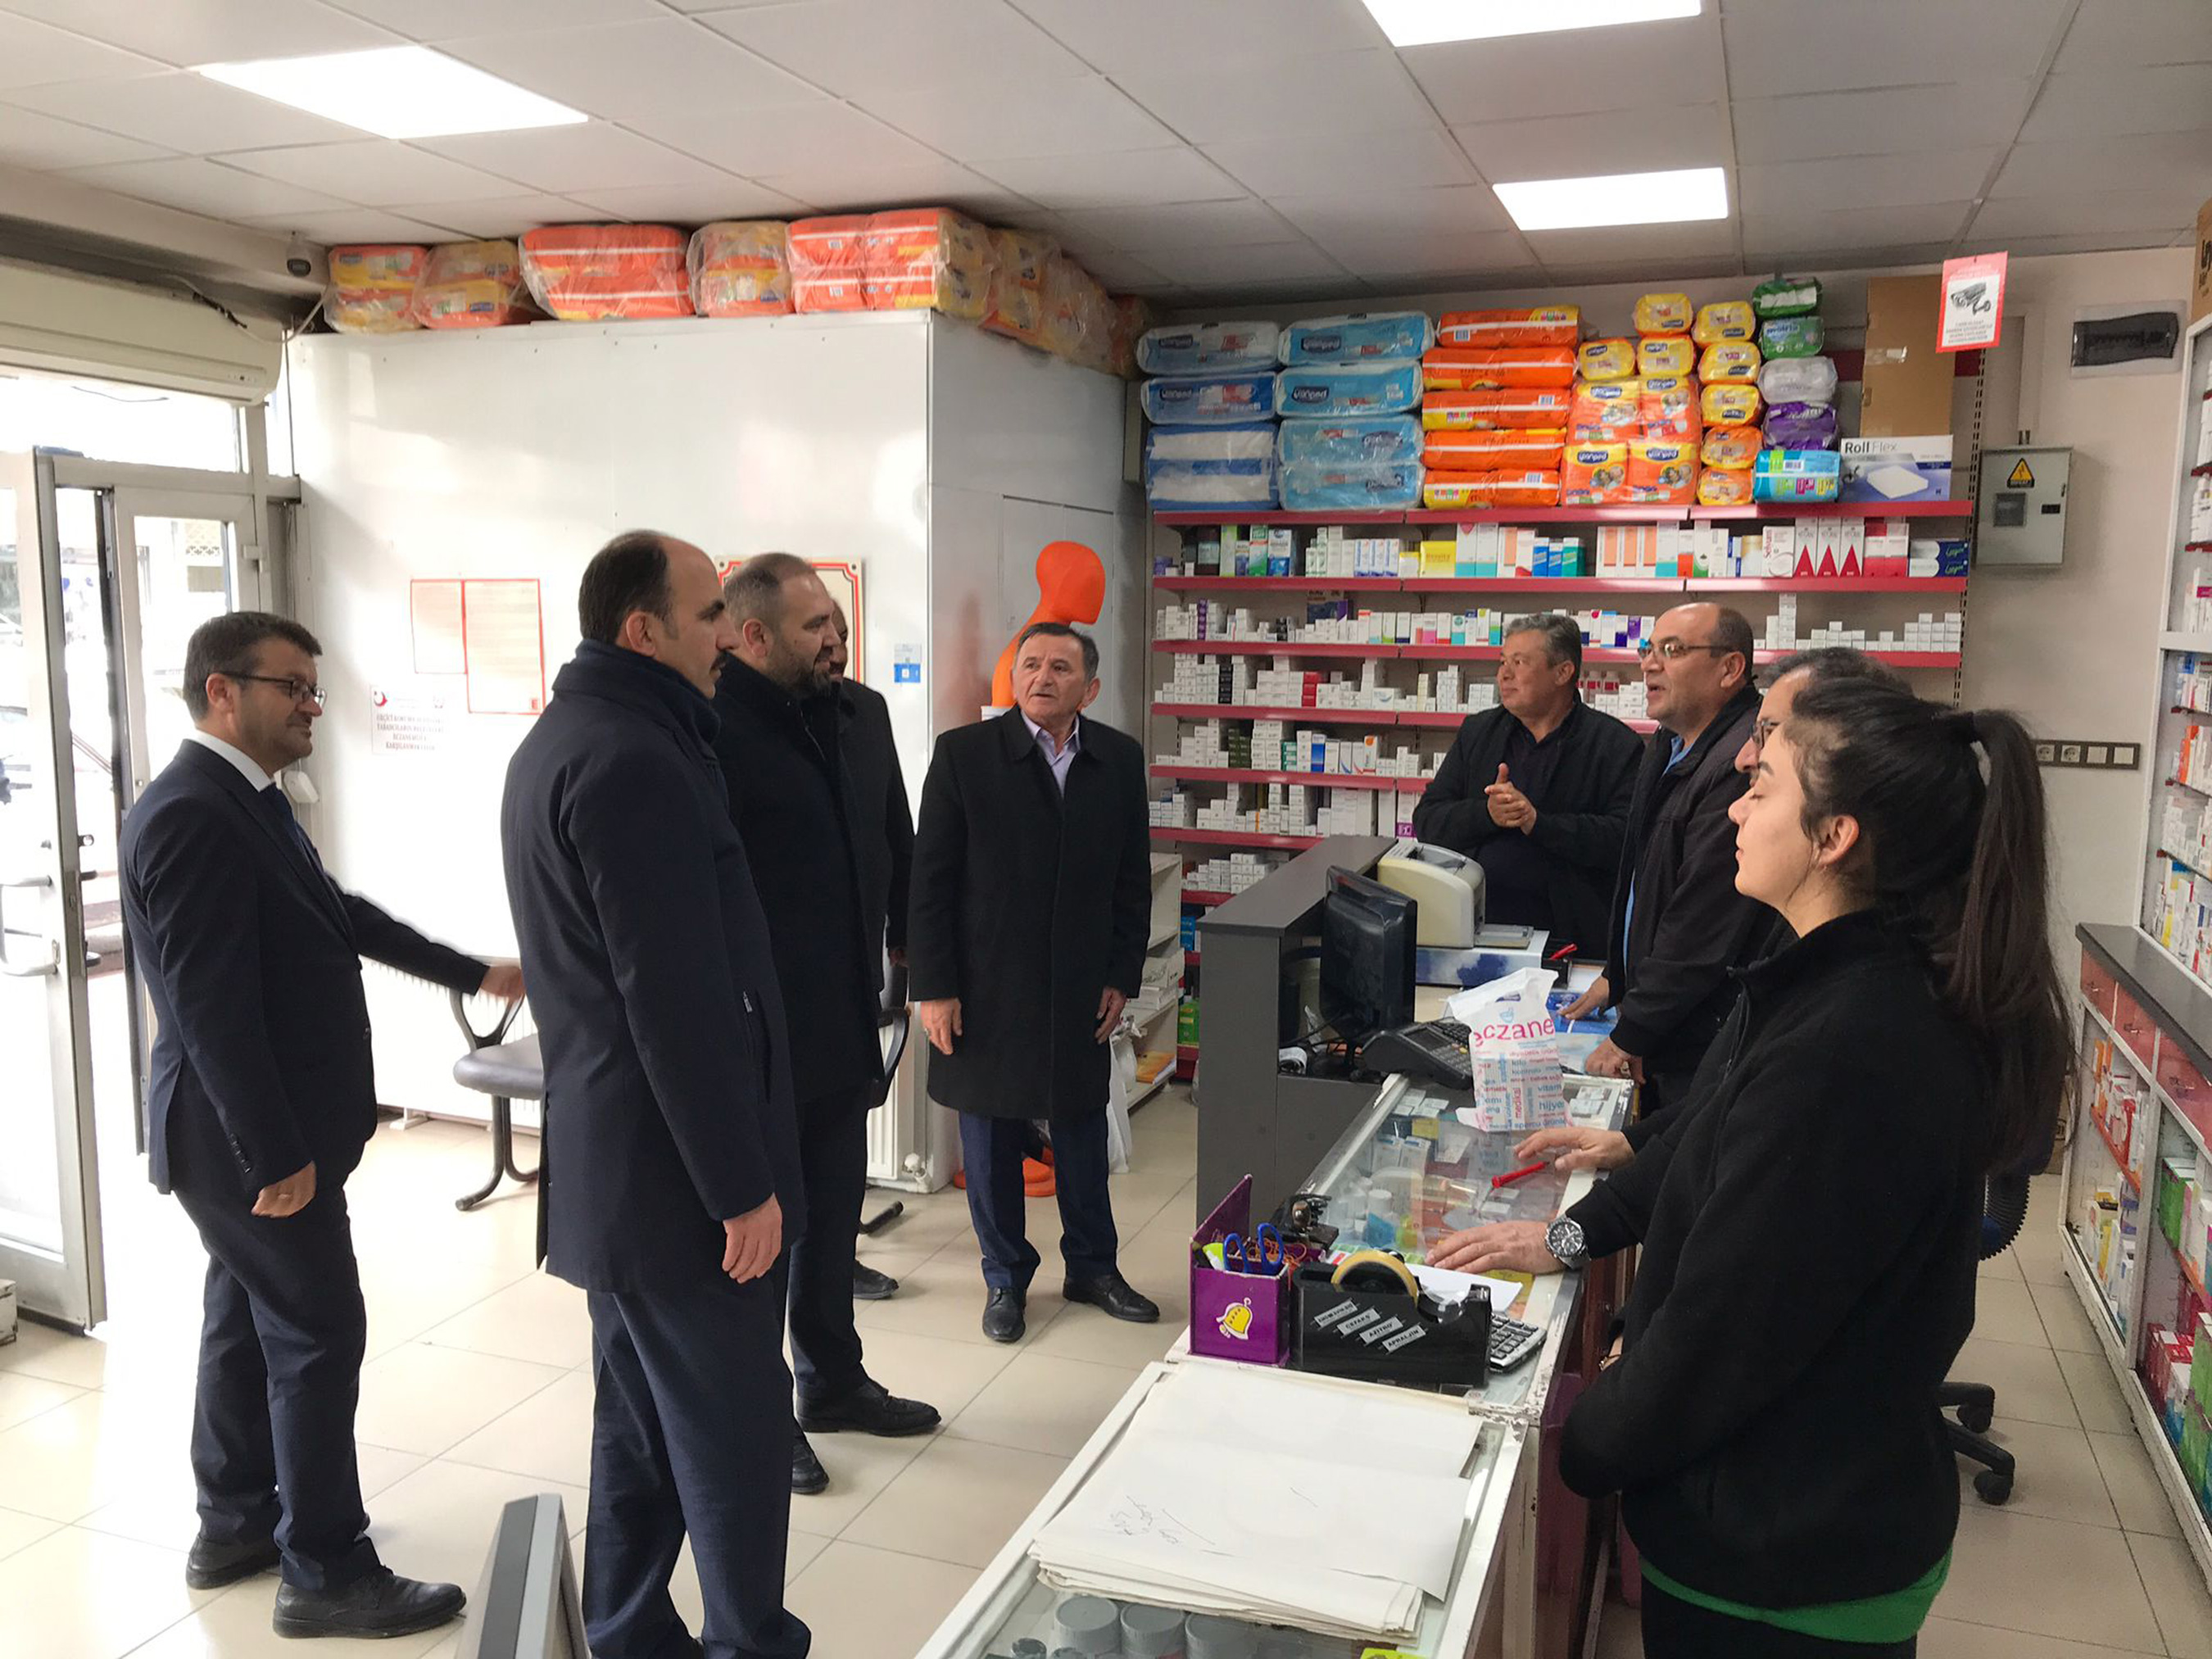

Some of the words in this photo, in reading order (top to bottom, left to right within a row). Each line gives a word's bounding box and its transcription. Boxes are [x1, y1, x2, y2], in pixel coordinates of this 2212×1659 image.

[1845, 441, 1870, 454] Roll
[1872, 441, 1897, 452] Flex
[1474, 1018, 1555, 1047] eczane
